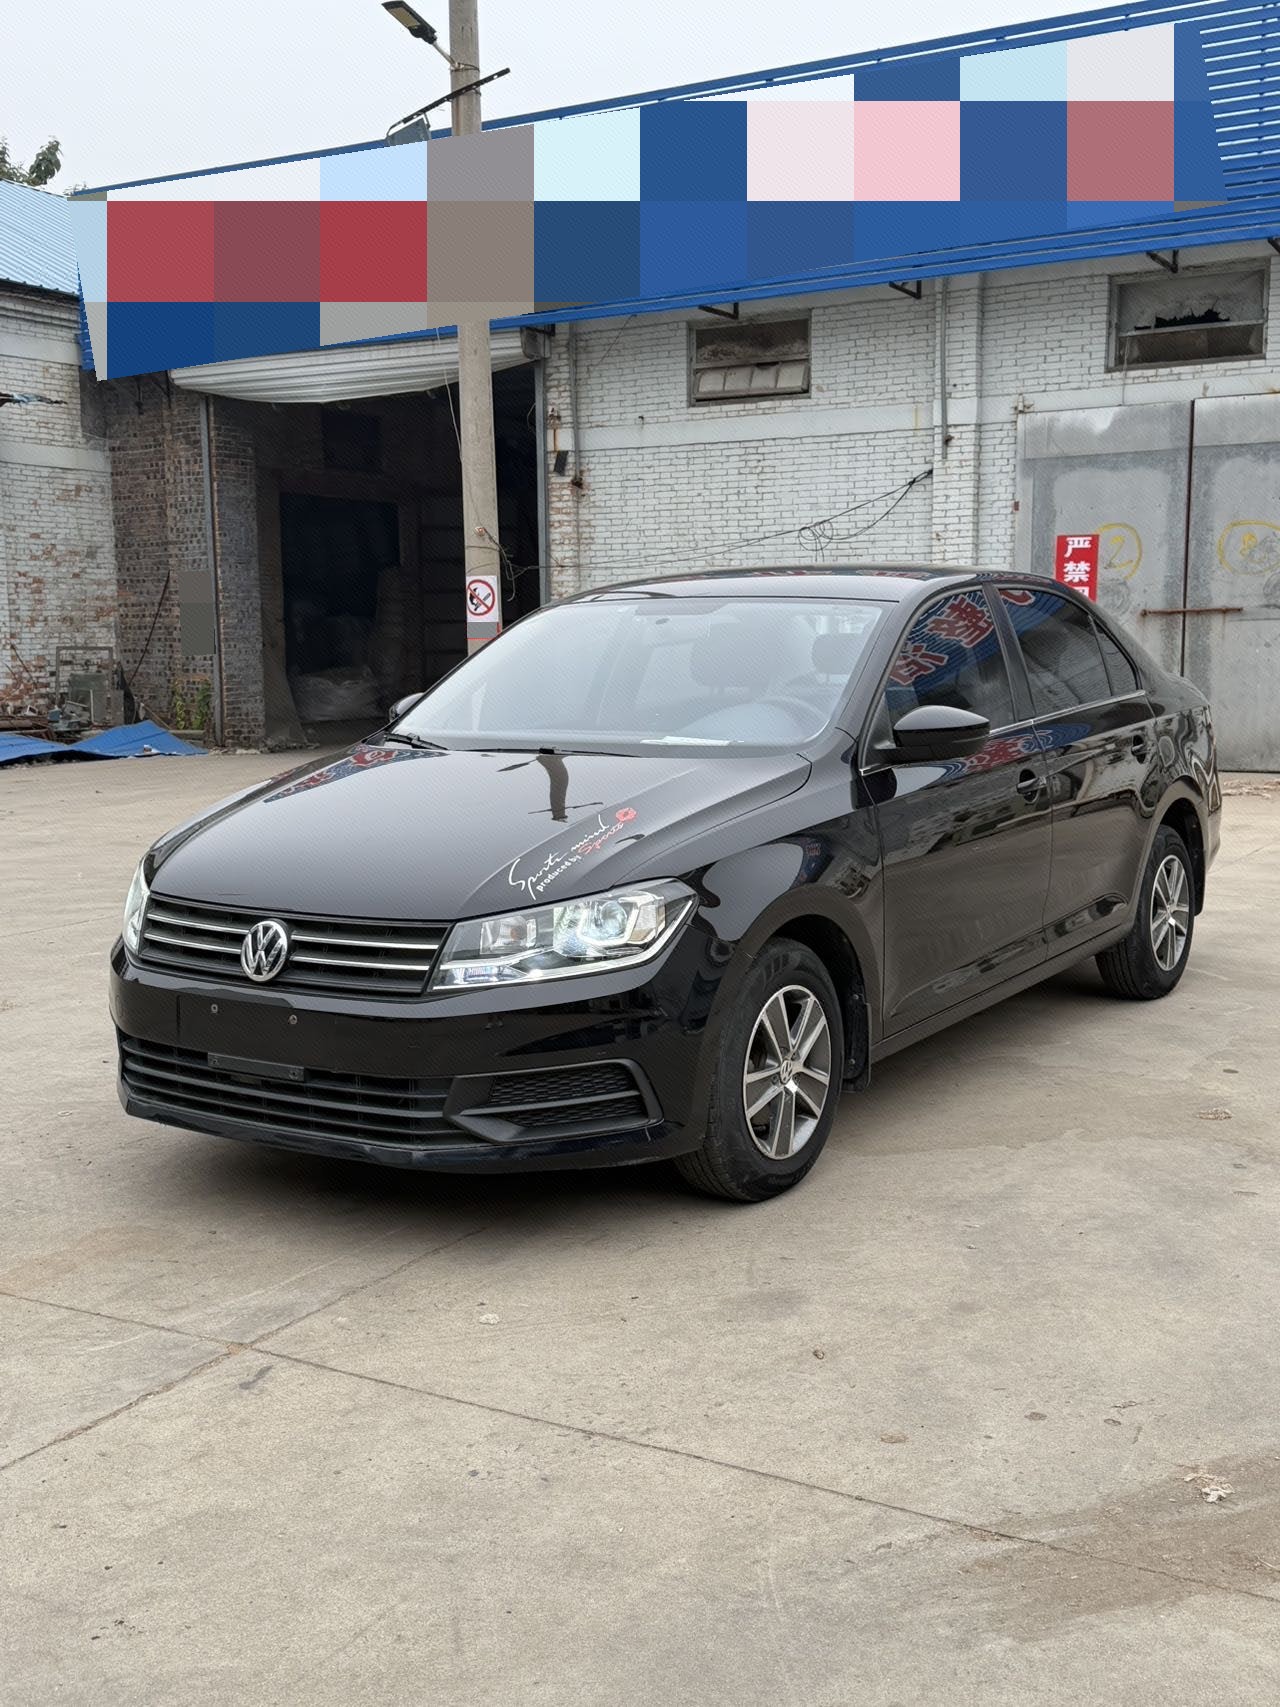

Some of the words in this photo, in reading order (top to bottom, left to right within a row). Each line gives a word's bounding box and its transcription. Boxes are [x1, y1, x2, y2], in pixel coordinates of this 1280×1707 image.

[570, 814, 610, 852] mind
[536, 858, 573, 892] produced
[569, 853, 583, 865] by
